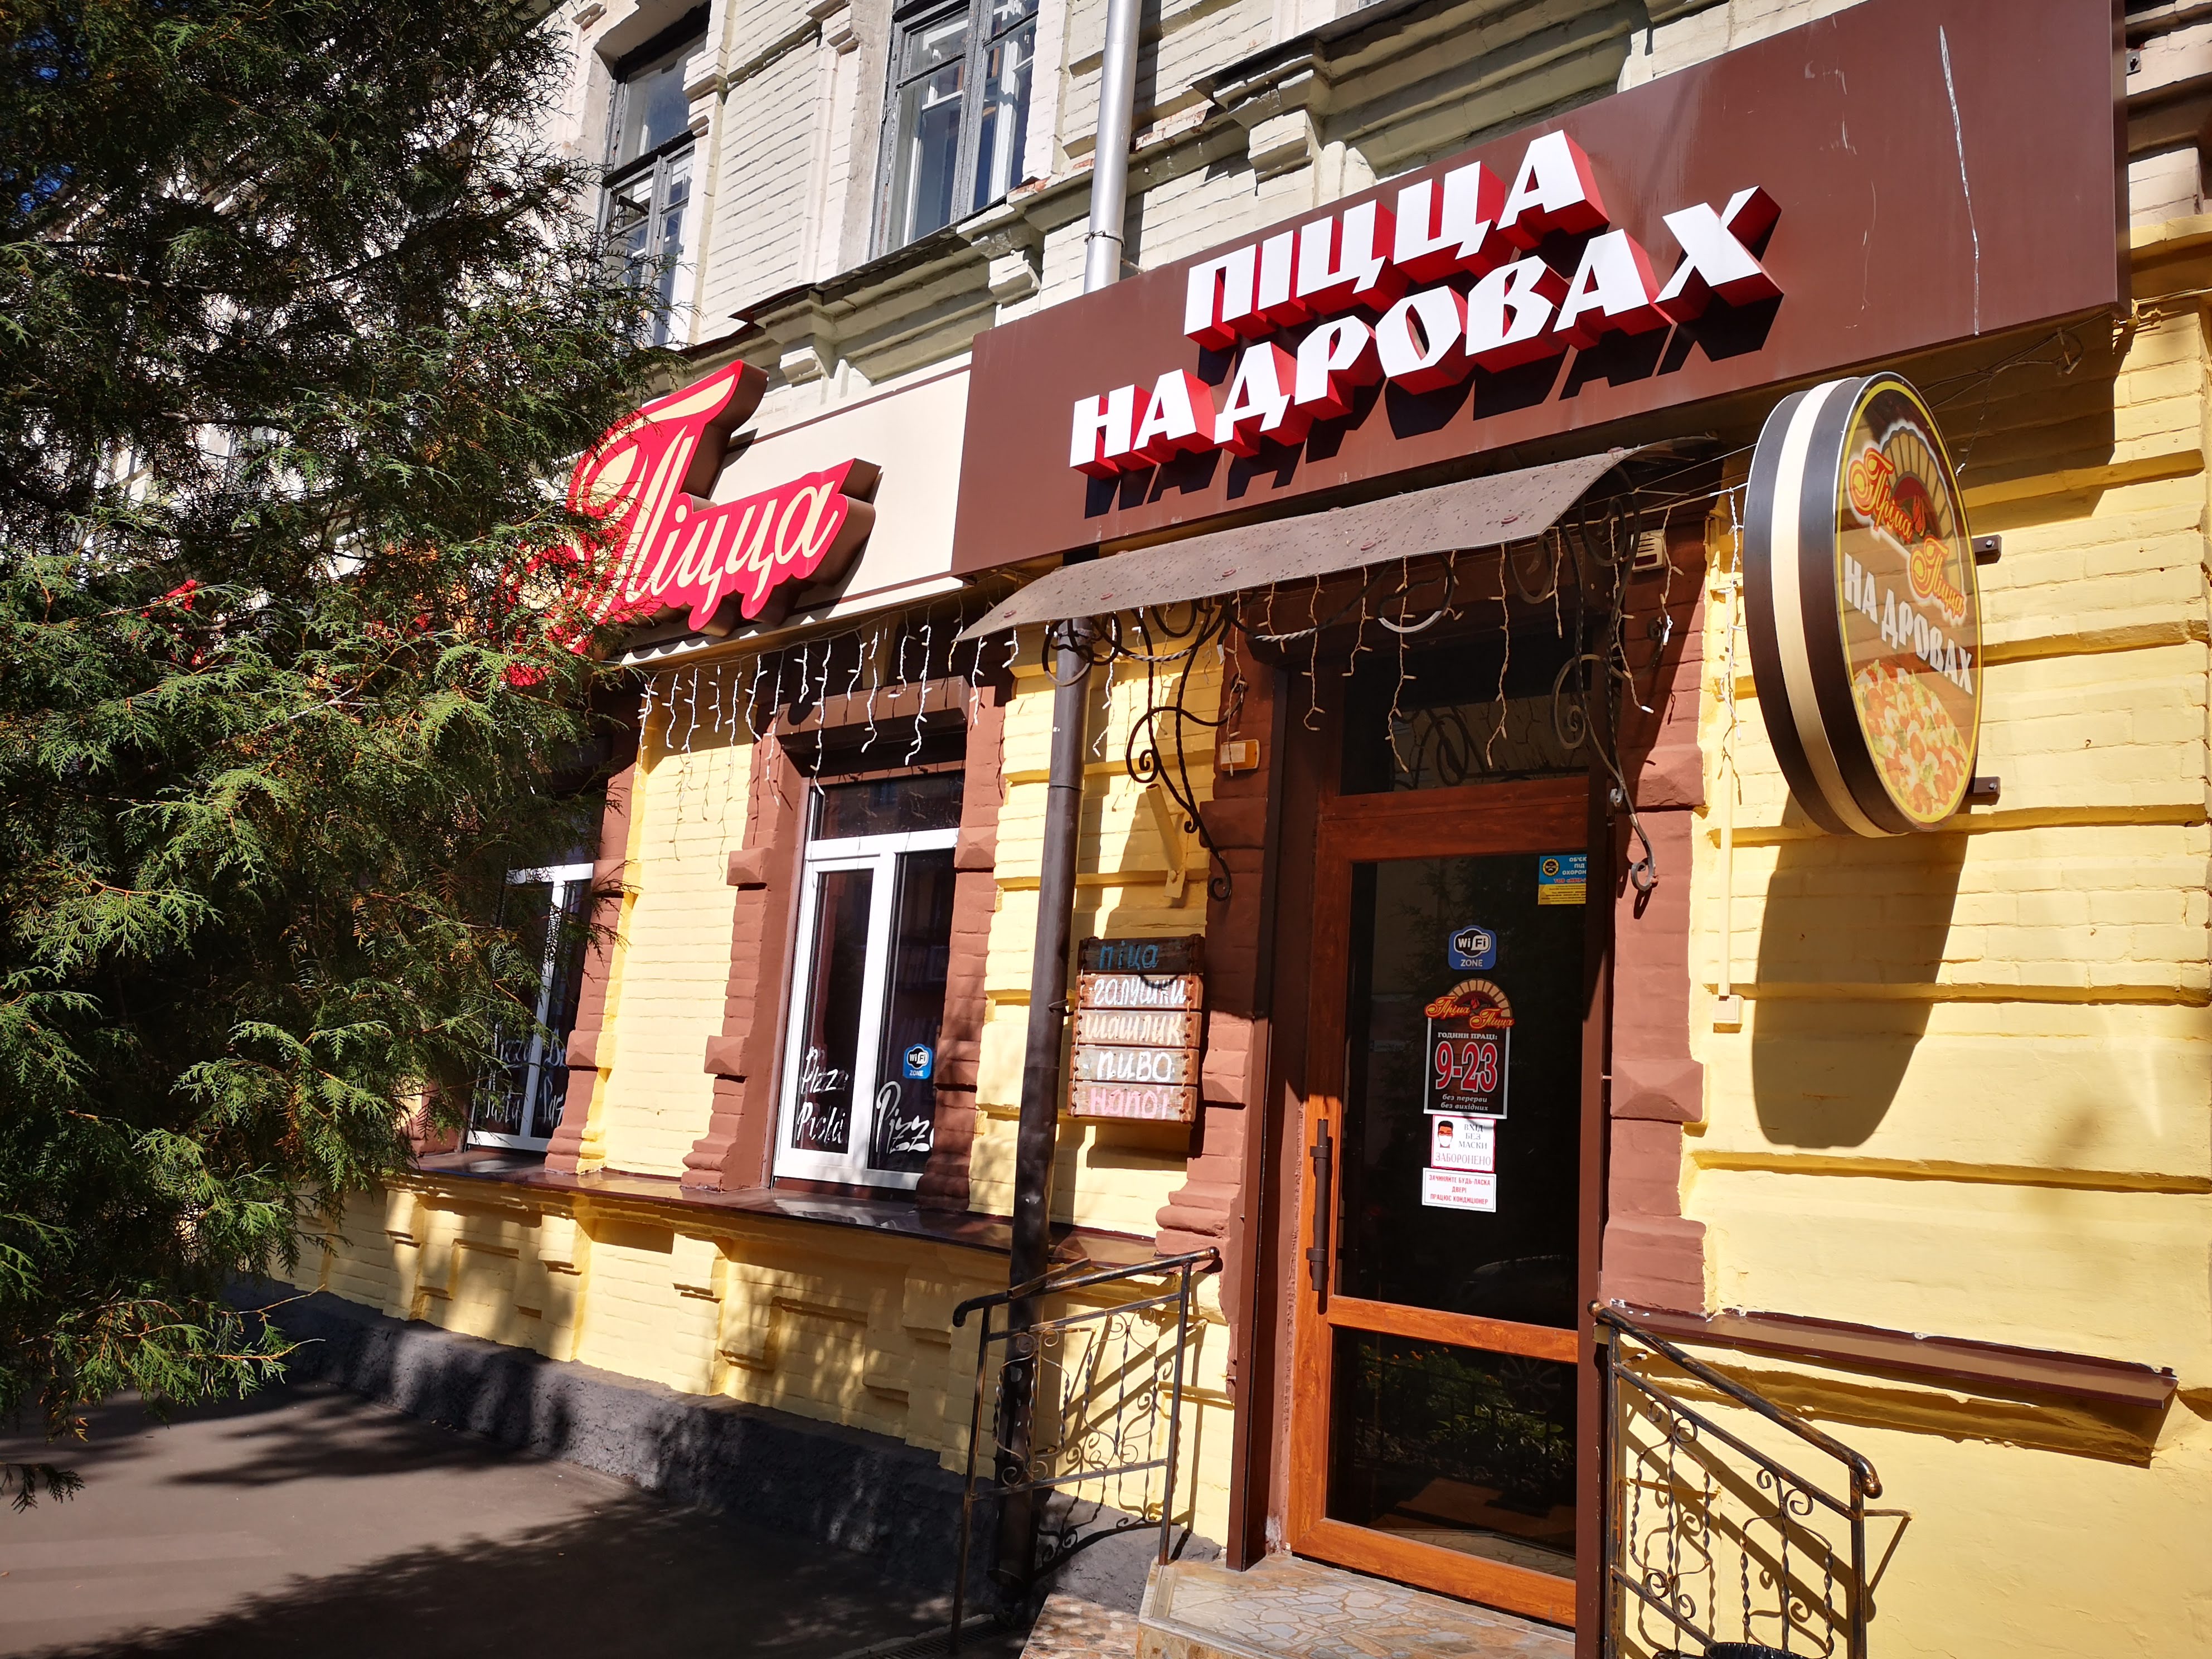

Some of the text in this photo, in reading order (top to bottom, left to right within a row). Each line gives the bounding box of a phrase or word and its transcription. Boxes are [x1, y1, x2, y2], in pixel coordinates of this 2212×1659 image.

[1185, 130, 1589, 341] ПІЦЦА
[1070, 186, 1764, 472] НА ДРОВАХ
[1848, 448, 1913, 541] Пріма
[1910, 535, 1966, 618] Піцца
[1844, 552, 1973, 696] НА ДРОВАХ
[1099, 940, 1159, 971] піца
[1425, 996, 1471, 1018] Пріма
[1469, 1008, 1514, 1029] Піцца
[1085, 1012, 1181, 1046] шашлик
[1097, 1051, 1173, 1082] пиво
[1434, 1040, 1498, 1093] 9-23
[1464, 1123, 1483, 1133] ВХІД
[1435, 1152, 1491, 1166] ЗАБОРОНЕНО
[1458, 1141, 1487, 1149] МАСКИ
[1430, 1194, 1488, 1205] ПРАЦЮЄ КОНДИЦІОНЕР
